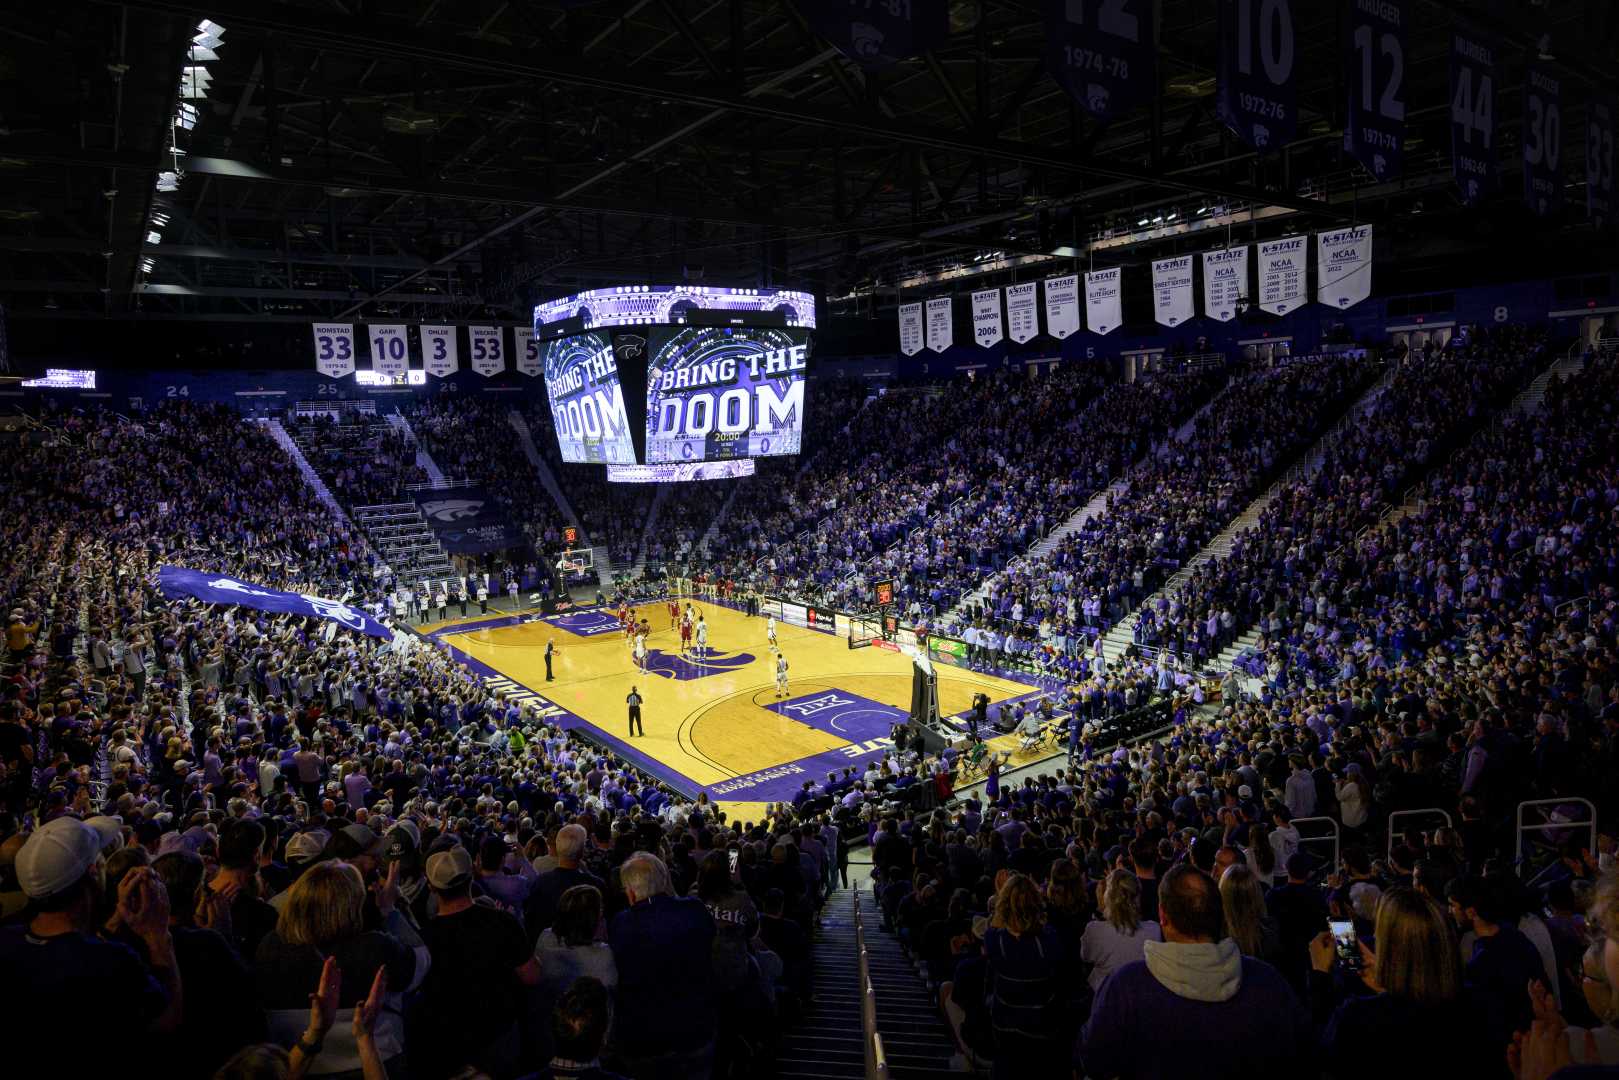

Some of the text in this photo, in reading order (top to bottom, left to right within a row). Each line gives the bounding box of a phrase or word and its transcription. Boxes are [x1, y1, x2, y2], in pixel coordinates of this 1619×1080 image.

[1064, 45, 1128, 80] 1974-78
[1354, 24, 1405, 121] 12
[1240, 91, 1287, 120] 1972-76
[1451, 65, 1492, 150] 44
[1525, 95, 1560, 172] 30
[1323, 230, 1367, 243] K-STATE
[1262, 241, 1302, 253] K-STATE
[1333, 249, 1355, 258] NCAA
[1207, 250, 1243, 262] K-STATE
[1156, 259, 1188, 270] K-STATE
[1271, 259, 1291, 267] NCAA
[1088, 271, 1118, 281] K-STATE
[1216, 268, 1234, 276] NCAA
[1008, 285, 1033, 295] K-STATE
[1048, 279, 1074, 288] K-STATE
[974, 292, 997, 300] K-STATE
[1493, 306, 1508, 322] 8
[978, 327, 996, 336] 2006
[318, 336, 351, 360] 33
[374, 337, 405, 360] 10
[433, 338, 447, 360] 3
[474, 338, 501, 360] 53
[552, 345, 617, 398] BRING THE
[662, 344, 807, 390] BRING THE
[167, 385, 190, 398] 24
[318, 384, 337, 394] 25
[440, 383, 457, 392] 26
[556, 384, 627, 440] DOOM
[658, 380, 805, 433] DOOM
[715, 432, 739, 442] 20:00
[761, 438, 770, 453] 0
